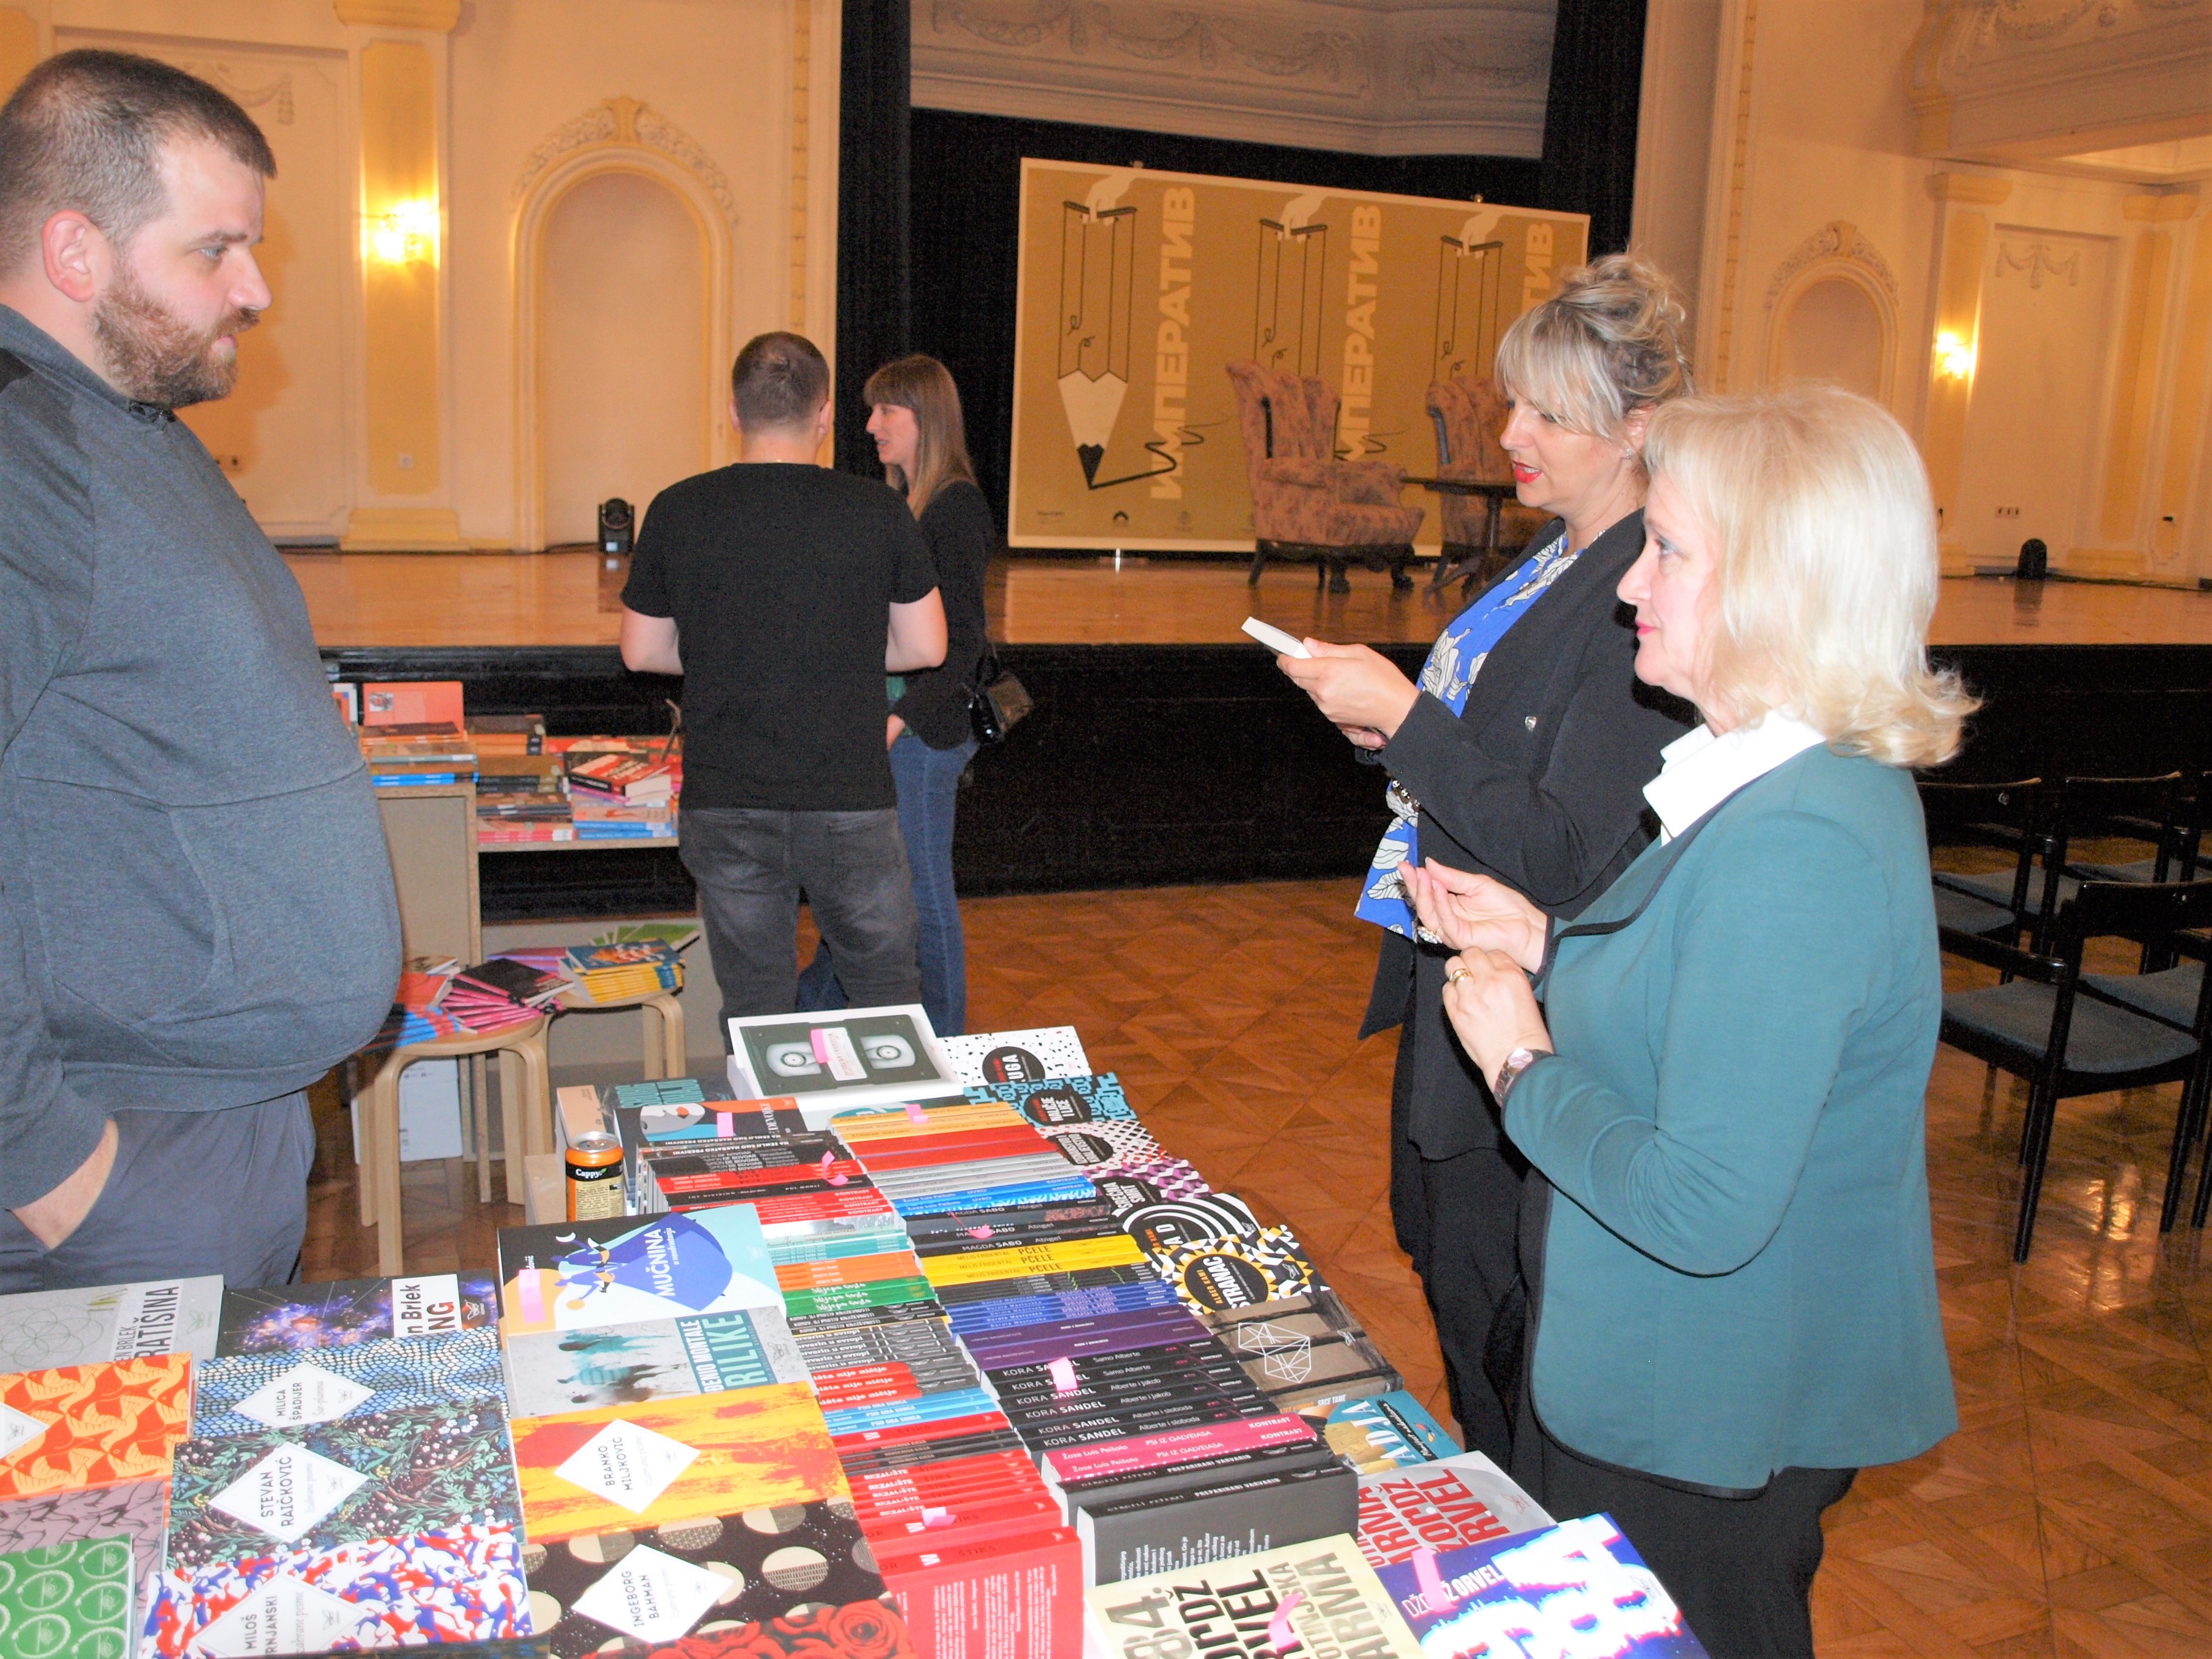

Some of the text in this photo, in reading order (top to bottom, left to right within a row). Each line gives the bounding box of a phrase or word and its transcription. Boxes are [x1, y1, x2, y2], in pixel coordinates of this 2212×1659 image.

[1150, 186, 1196, 500] ИМПЕРАТИВ
[1338, 204, 1381, 462] МПЕРАТИВ
[1002, 1054, 1025, 1082] UGA
[575, 1168, 602, 1181] Cappy
[1121, 1184, 1145, 1204] SMRT
[1018, 1245, 1051, 1255] PČELE
[1155, 1224, 1183, 1245] AD
[643, 1228, 675, 1296] MUČNINA
[1021, 1253, 1055, 1264] PČELE
[1028, 1262, 1063, 1274] PČELE
[1202, 1256, 1251, 1309] STRANAC
[400, 1284, 422, 1321] Brlek
[133, 1285, 180, 1358] RATIŠINA
[116, 1326, 136, 1351] BRLEK
[680, 1319, 711, 1358] MONTALE
[702, 1313, 768, 1388] RILIKE
[843, 1350, 870, 1359] evropi
[848, 1358, 875, 1366] evropi
[1003, 1366, 1034, 1377] KORA
[1115, 1351, 1141, 1360] Alberte
[837, 1366, 887, 1379] nije ničije
[843, 1376, 894, 1390] nije ničije
[1012, 1380, 1043, 1390] KORA
[1125, 1364, 1151, 1373] Alberte
[276, 1389, 287, 1418] MILICA
[289, 1382, 303, 1421] ŠPADIJER
[846, 1389, 897, 1403] nije ničije
[1017, 1395, 1048, 1405] KORA
[1050, 1387, 1096, 1399] SANDEL
[1111, 1381, 1137, 1390] Alberte
[1025, 1409, 1057, 1419] KORA
[1059, 1401, 1106, 1414] SANDEL
[1121, 1394, 1147, 1404] Alberte
[1038, 1424, 1070, 1435] KORA
[1073, 1416, 1119, 1429] SANDEL
[1133, 1410, 1159, 1419] Alberte
[1164, 1404, 1193, 1414] sloboda
[1044, 1436, 1076, 1447] KORA
[1078, 1428, 1126, 1441] SANDEL
[1139, 1422, 1165, 1432] Alberte
[1171, 1416, 1200, 1426] sloboda
[1342, 1400, 1416, 1460] ADJA
[1062, 1450, 1082, 1460] Žoze
[1083, 1448, 1099, 1457] Luis
[1100, 1444, 1128, 1454] Peišoto
[1145, 1436, 1159, 1446] PSI
[1168, 1430, 1213, 1442] GALVEIASA
[1248, 1417, 1291, 1429] KONTRAST
[1072, 1462, 1092, 1473] Žoze
[1093, 1460, 1110, 1470] Luis
[1111, 1456, 1139, 1467] Peišoto
[1156, 1449, 1170, 1458] PSI
[1179, 1443, 1224, 1455] GALVEIASA
[1260, 1428, 1303, 1440] KONTRAST
[598, 1445, 615, 1486] BRANKO
[1167, 1460, 1216, 1473] PREPARIRANI
[260, 1471, 273, 1517] STEVAN
[275, 1456, 295, 1527] RAIČKOVIĆ
[1194, 1483, 1244, 1497] PREPARIRANI
[1451, 1564, 1506, 1597] ORVEL
[621, 1570, 644, 1627] INGEBORG
[640, 1574, 660, 1619] BAHMAN
[241, 1614, 257, 1651] MILOŠ
[265, 1595, 278, 1655] RNJANSKI
